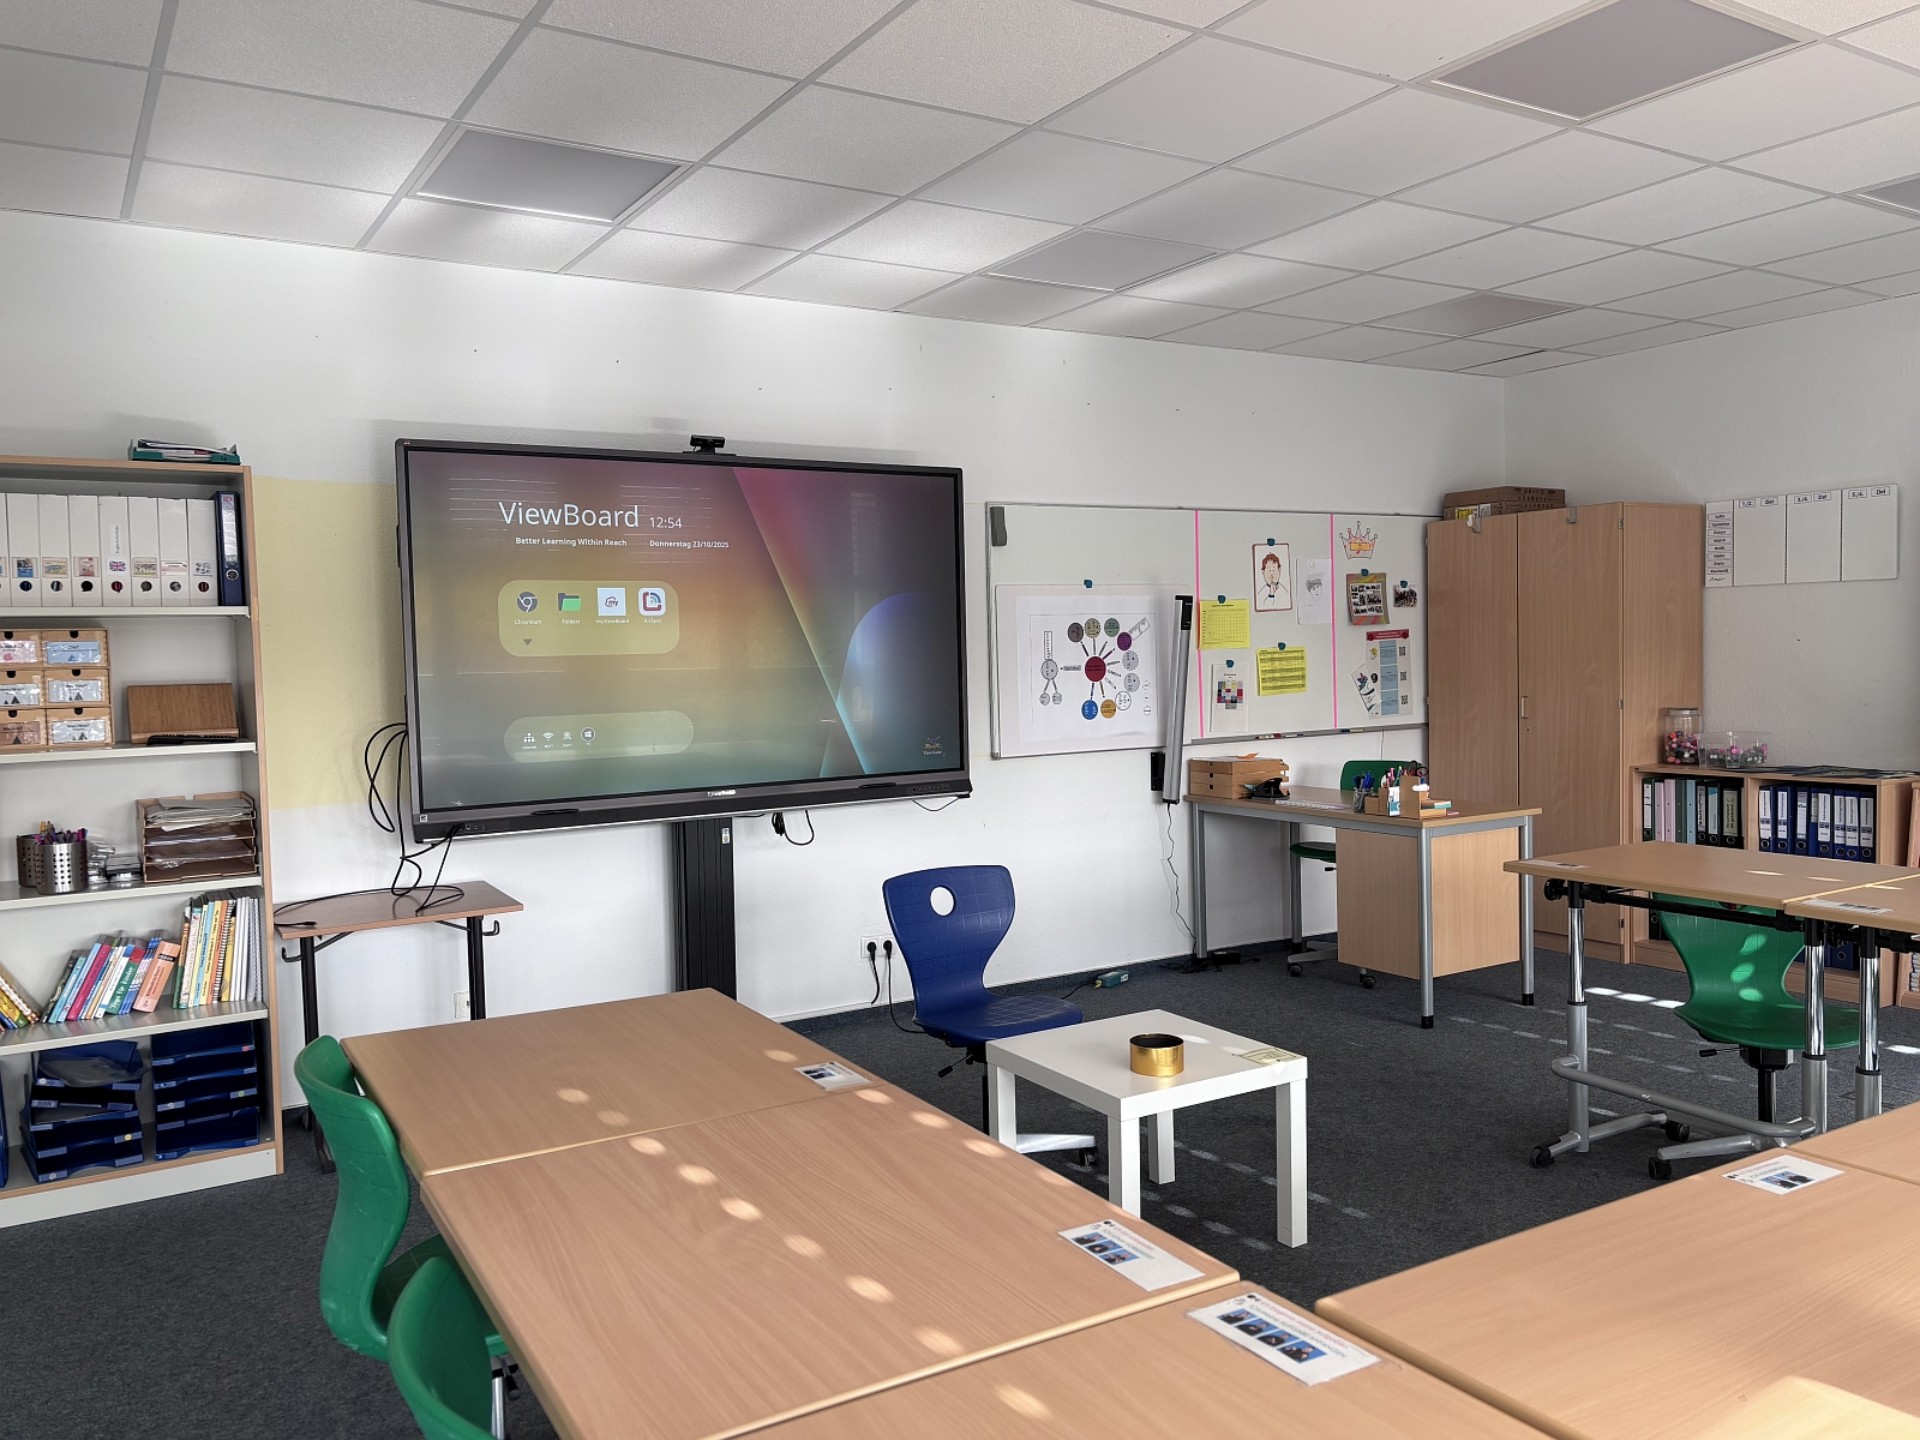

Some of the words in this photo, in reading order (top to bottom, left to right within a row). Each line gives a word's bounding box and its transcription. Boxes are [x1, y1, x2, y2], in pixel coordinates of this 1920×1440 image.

[499, 502, 640, 528] ViewBoard
[649, 516, 683, 529] 12:54
[515, 537, 541, 545] Better
[541, 537, 577, 547] Learning
[577, 538, 603, 546] Within
[604, 539, 627, 547] Reach
[649, 540, 692, 549] Donnerstag
